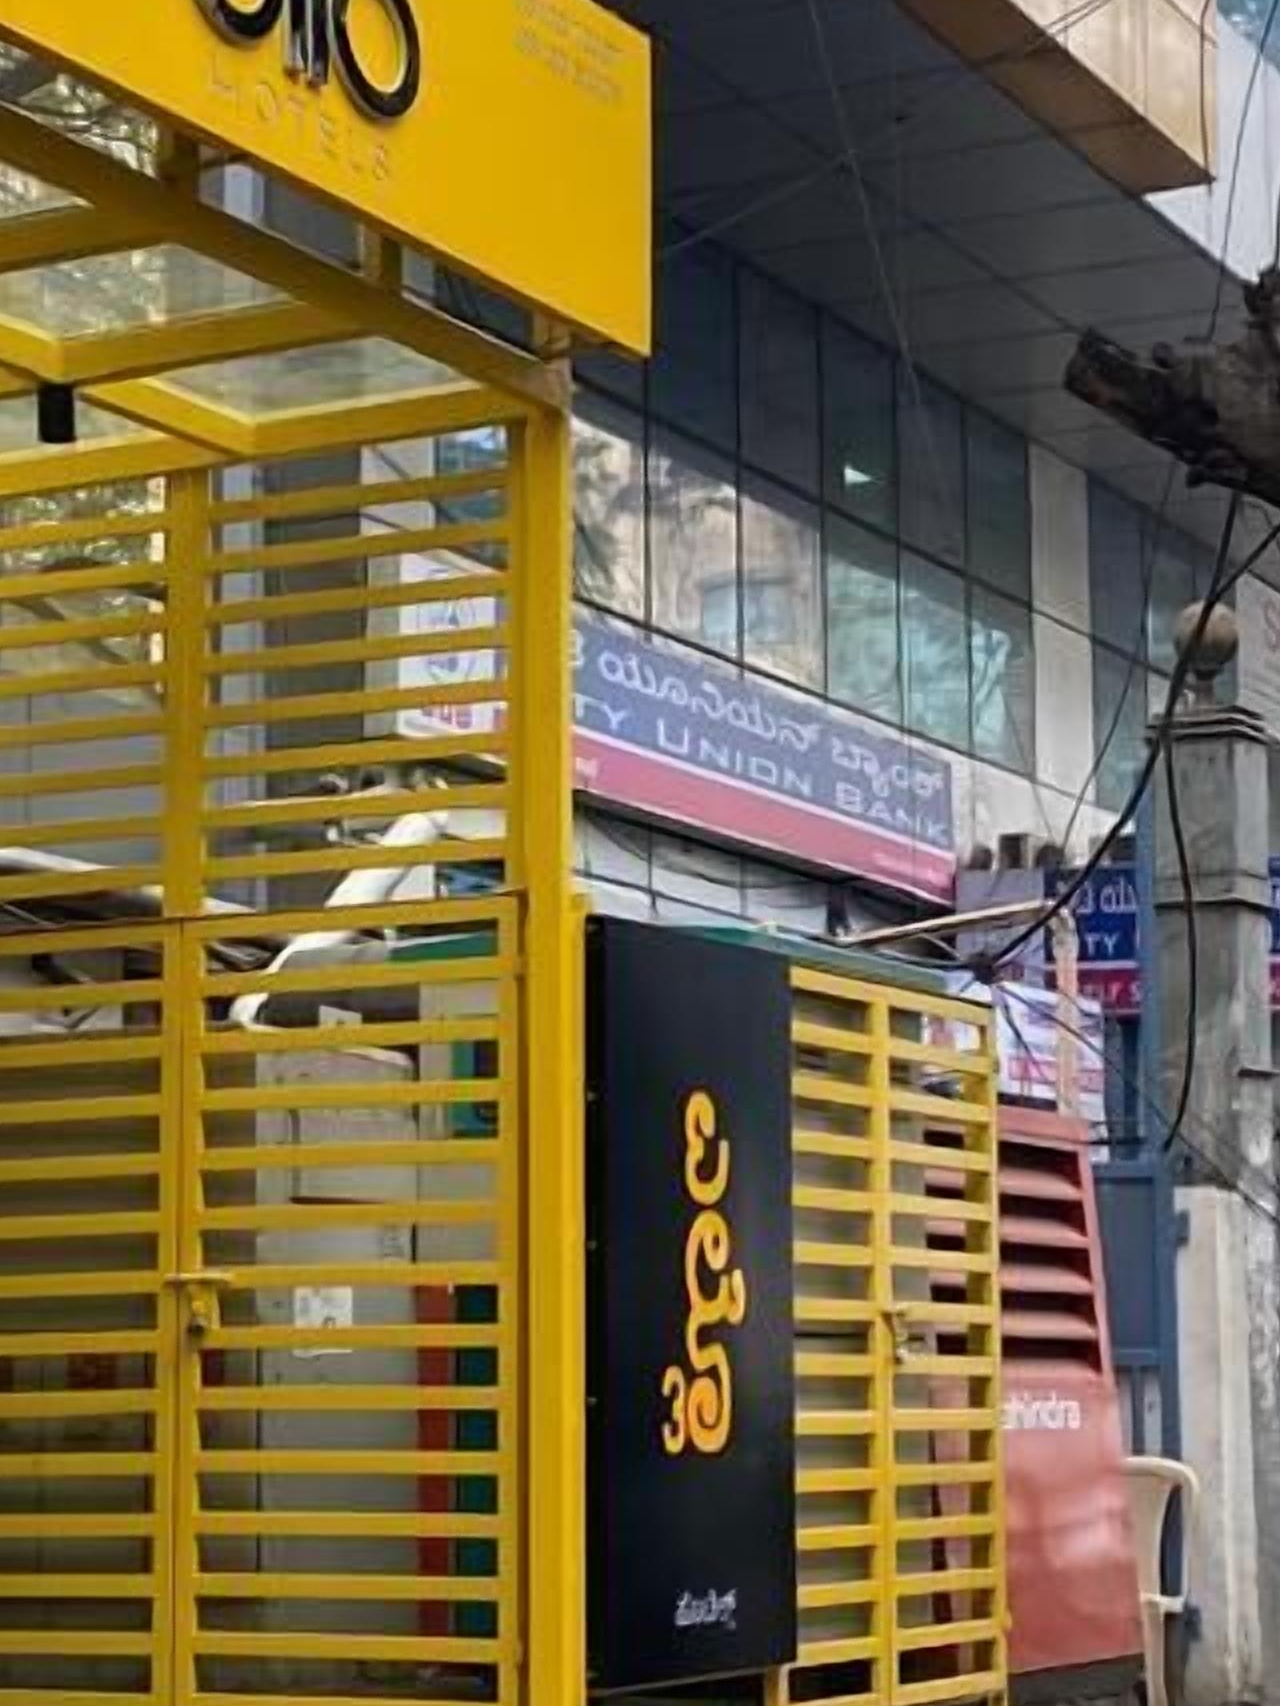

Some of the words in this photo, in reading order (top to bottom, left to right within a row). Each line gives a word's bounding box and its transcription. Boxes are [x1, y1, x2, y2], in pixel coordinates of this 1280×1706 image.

[575, 693, 628, 732] TY
[657, 718, 814, 798] UNION
[834, 780, 950, 849] BANK
[1084, 931, 1120, 956] TY
[1000, 1390, 1081, 1430] ahindra
